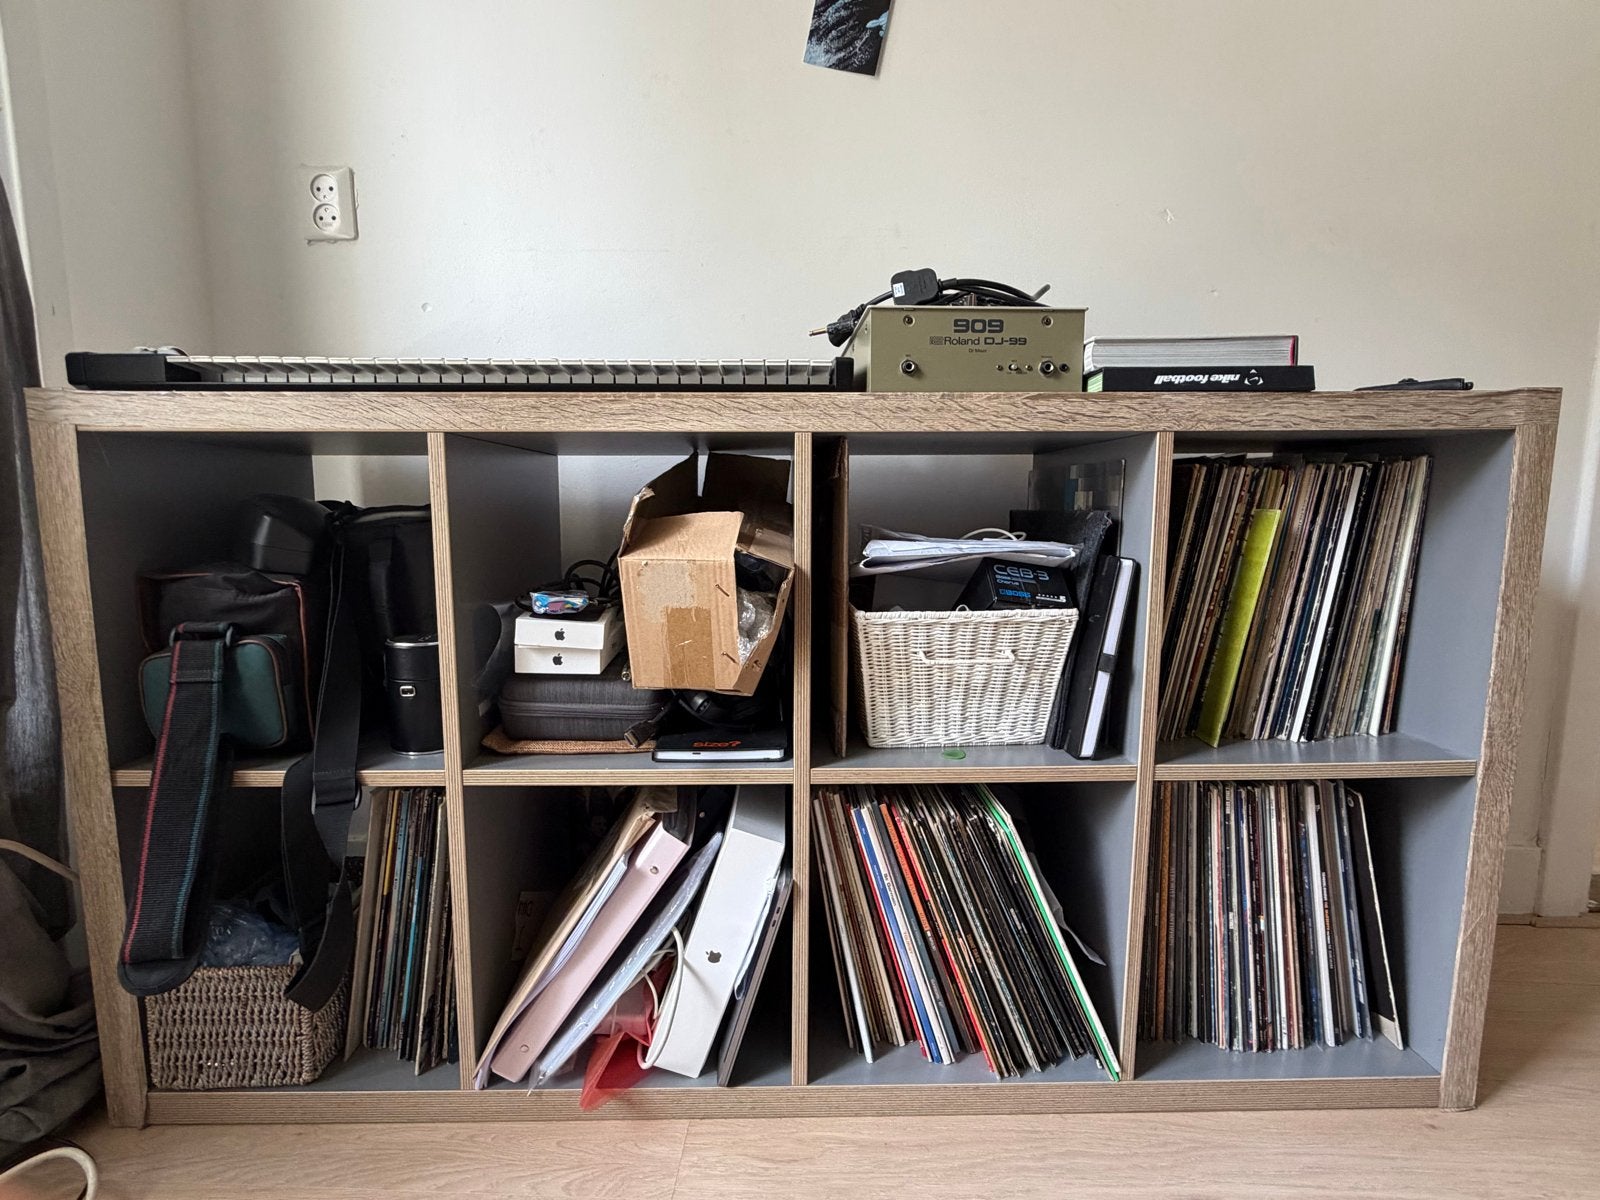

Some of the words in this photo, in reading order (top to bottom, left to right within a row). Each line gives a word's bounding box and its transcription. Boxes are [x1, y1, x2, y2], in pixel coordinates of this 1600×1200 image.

[953, 318, 1004, 334] 909
[944, 336, 980, 346] Roland
[984, 337, 1027, 346] DJ-99
[1153, 374, 1209, 385] football
[1210, 374, 1241, 384] nike
[993, 564, 1050, 581] CEB-3
[886, 882, 897, 907] Germain
